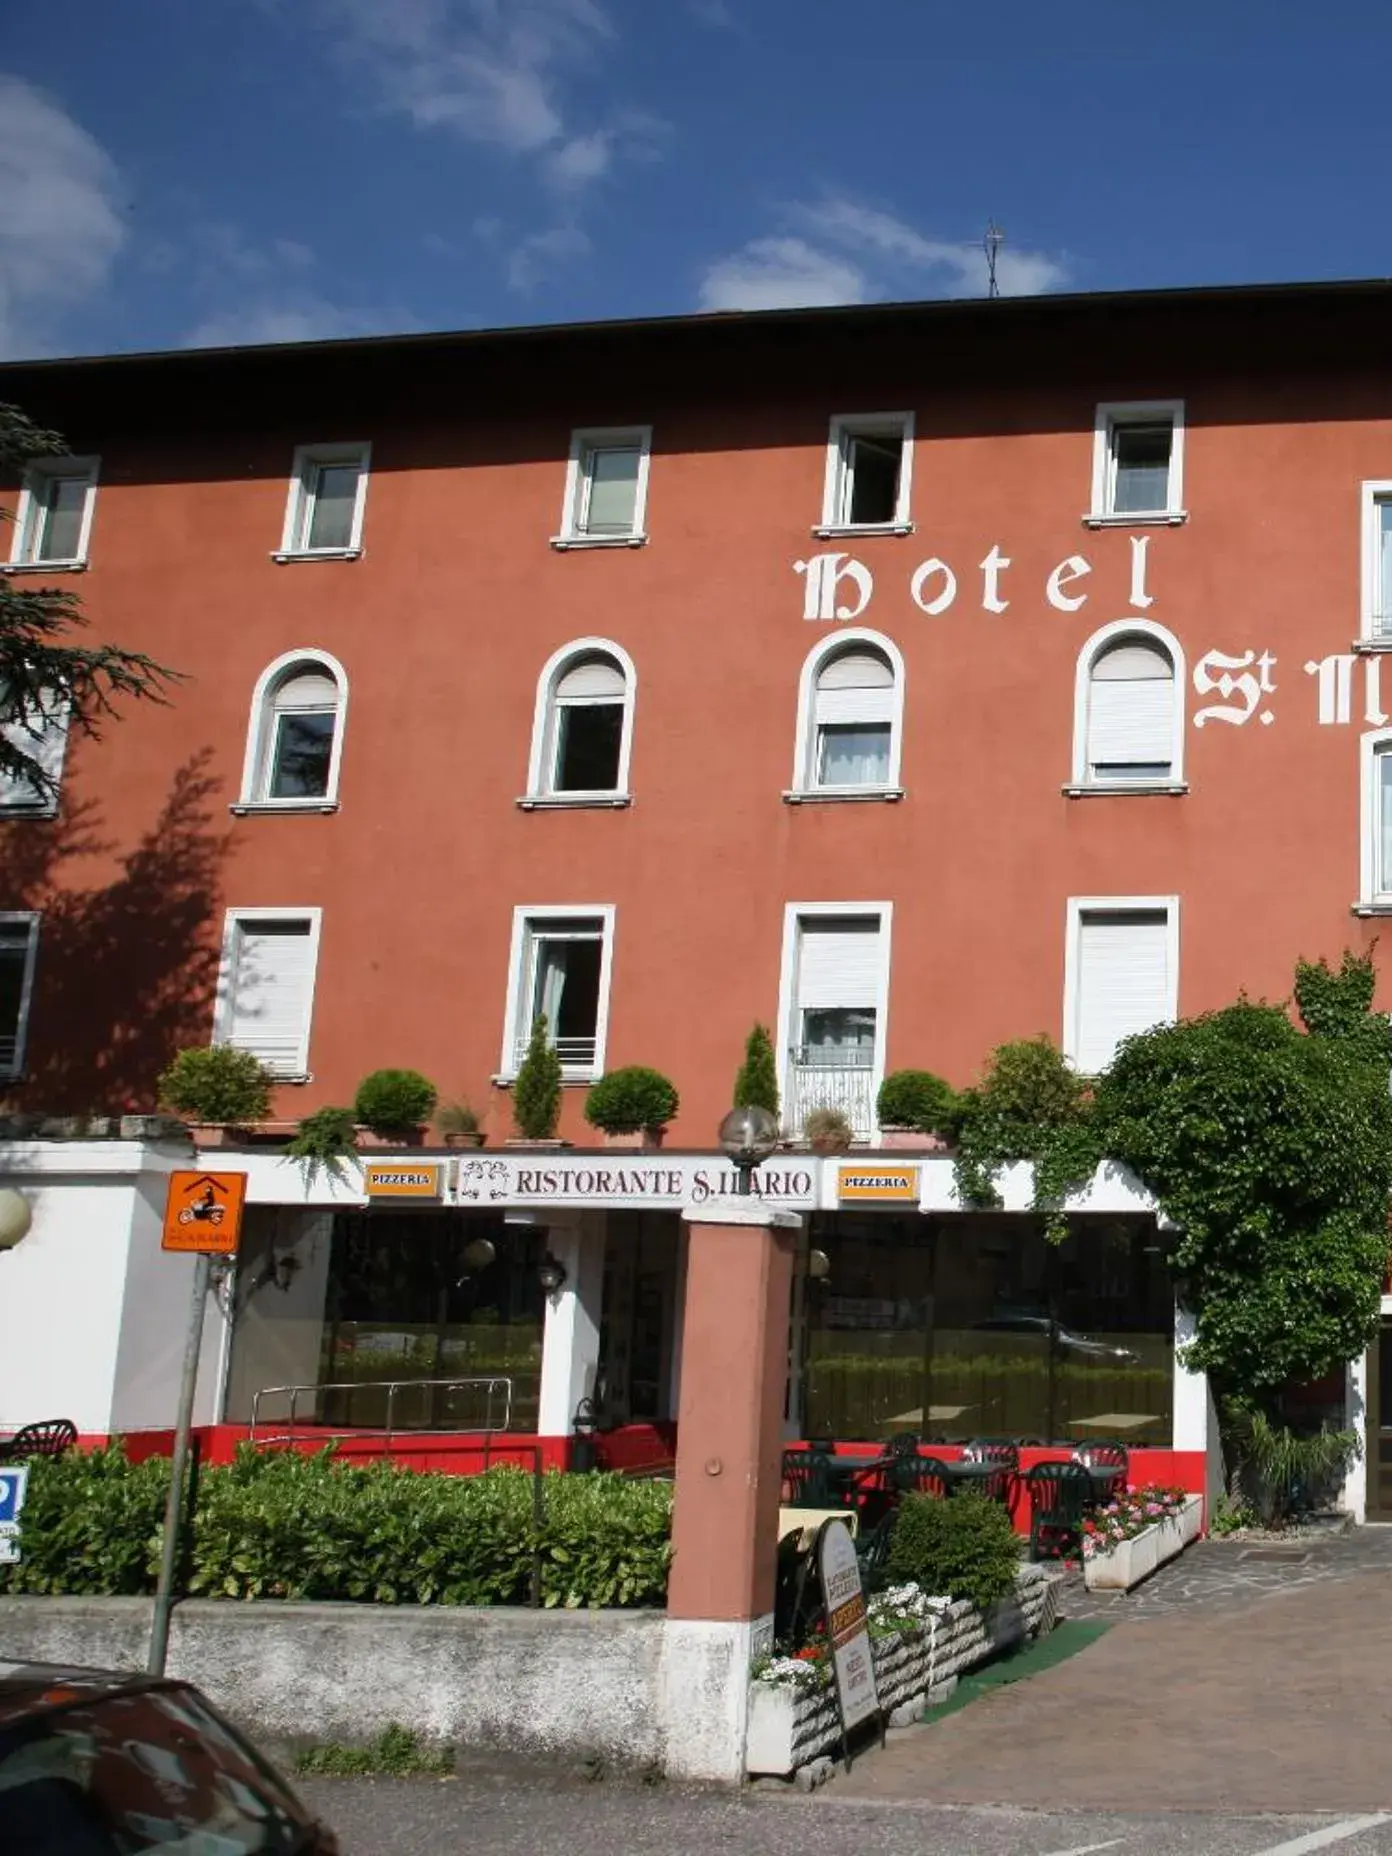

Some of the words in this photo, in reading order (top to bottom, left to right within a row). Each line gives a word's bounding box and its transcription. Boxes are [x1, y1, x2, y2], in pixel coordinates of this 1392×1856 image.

[792, 536, 1153, 621] Hotel
[371, 1173, 430, 1186] PIZZERIA
[516, 1169, 683, 1195] RISTORANTE
[843, 1176, 909, 1189] PIZZERIA
